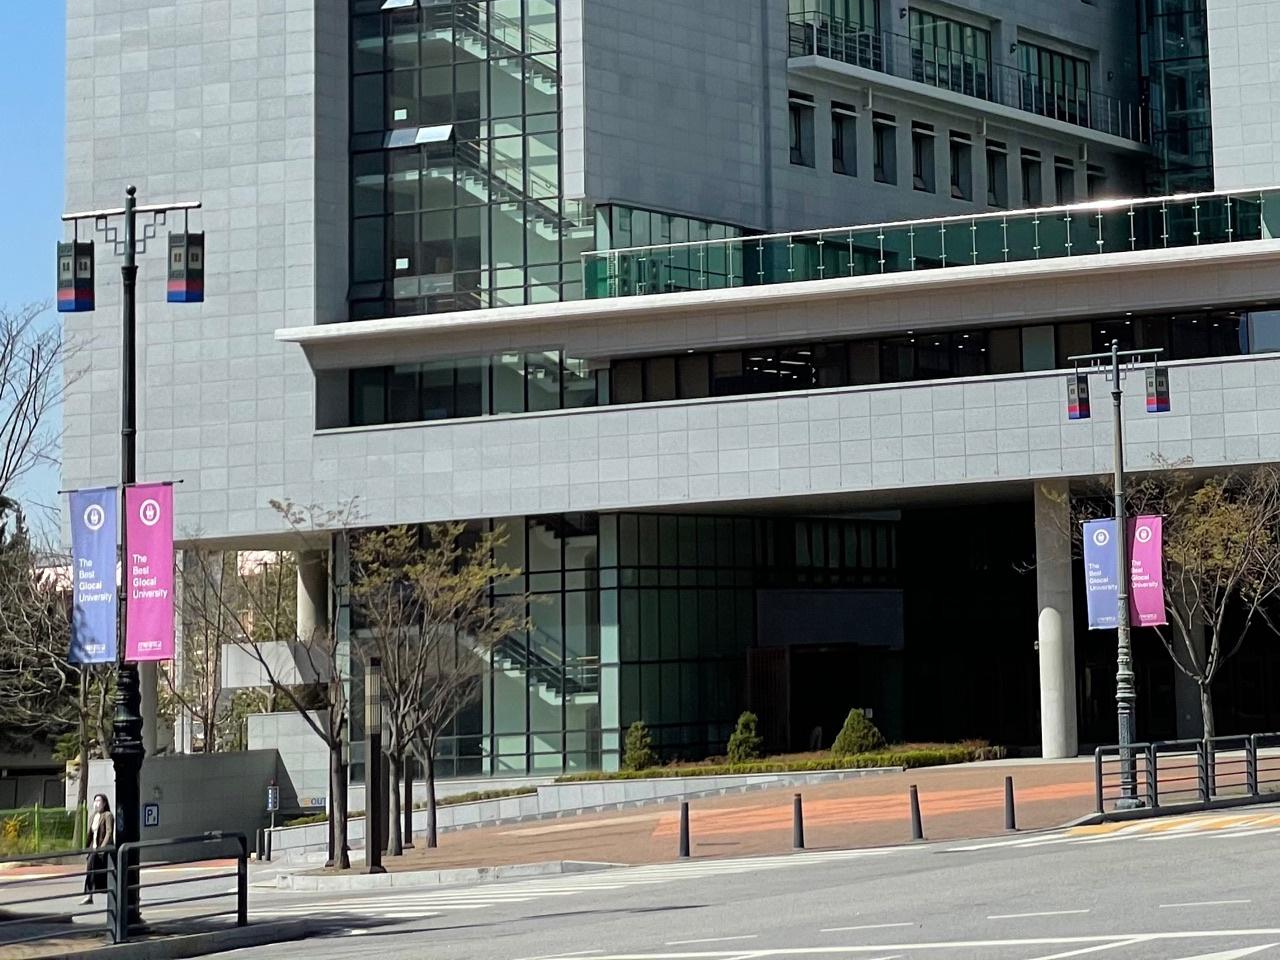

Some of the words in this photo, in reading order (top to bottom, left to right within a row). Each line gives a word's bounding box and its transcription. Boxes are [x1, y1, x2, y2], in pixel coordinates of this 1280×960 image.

[79, 558, 93, 568] The
[132, 554, 148, 564] The
[79, 570, 95, 580] Best
[132, 566, 150, 576] Best
[79, 581, 103, 591] Glocal
[132, 576, 157, 587] Glocal
[79, 591, 112, 603] University
[132, 588, 168, 600] University
